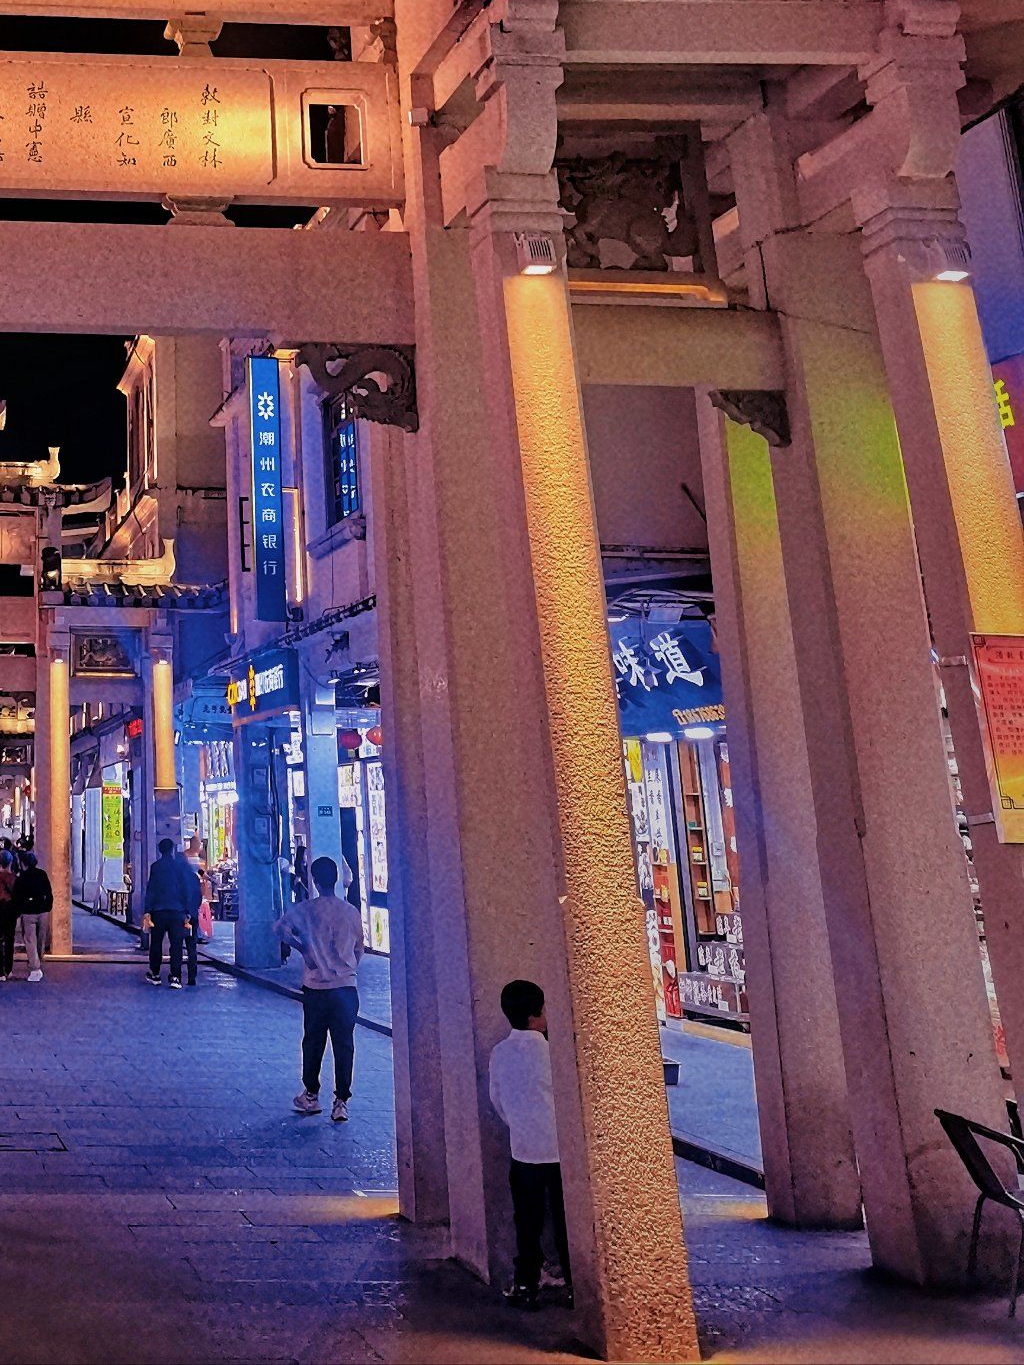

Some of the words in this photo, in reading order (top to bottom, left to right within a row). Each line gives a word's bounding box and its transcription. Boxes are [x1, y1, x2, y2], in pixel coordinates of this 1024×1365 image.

[259, 432, 277, 575] 潮州农商银行
[612, 632, 703, 694] 味道
